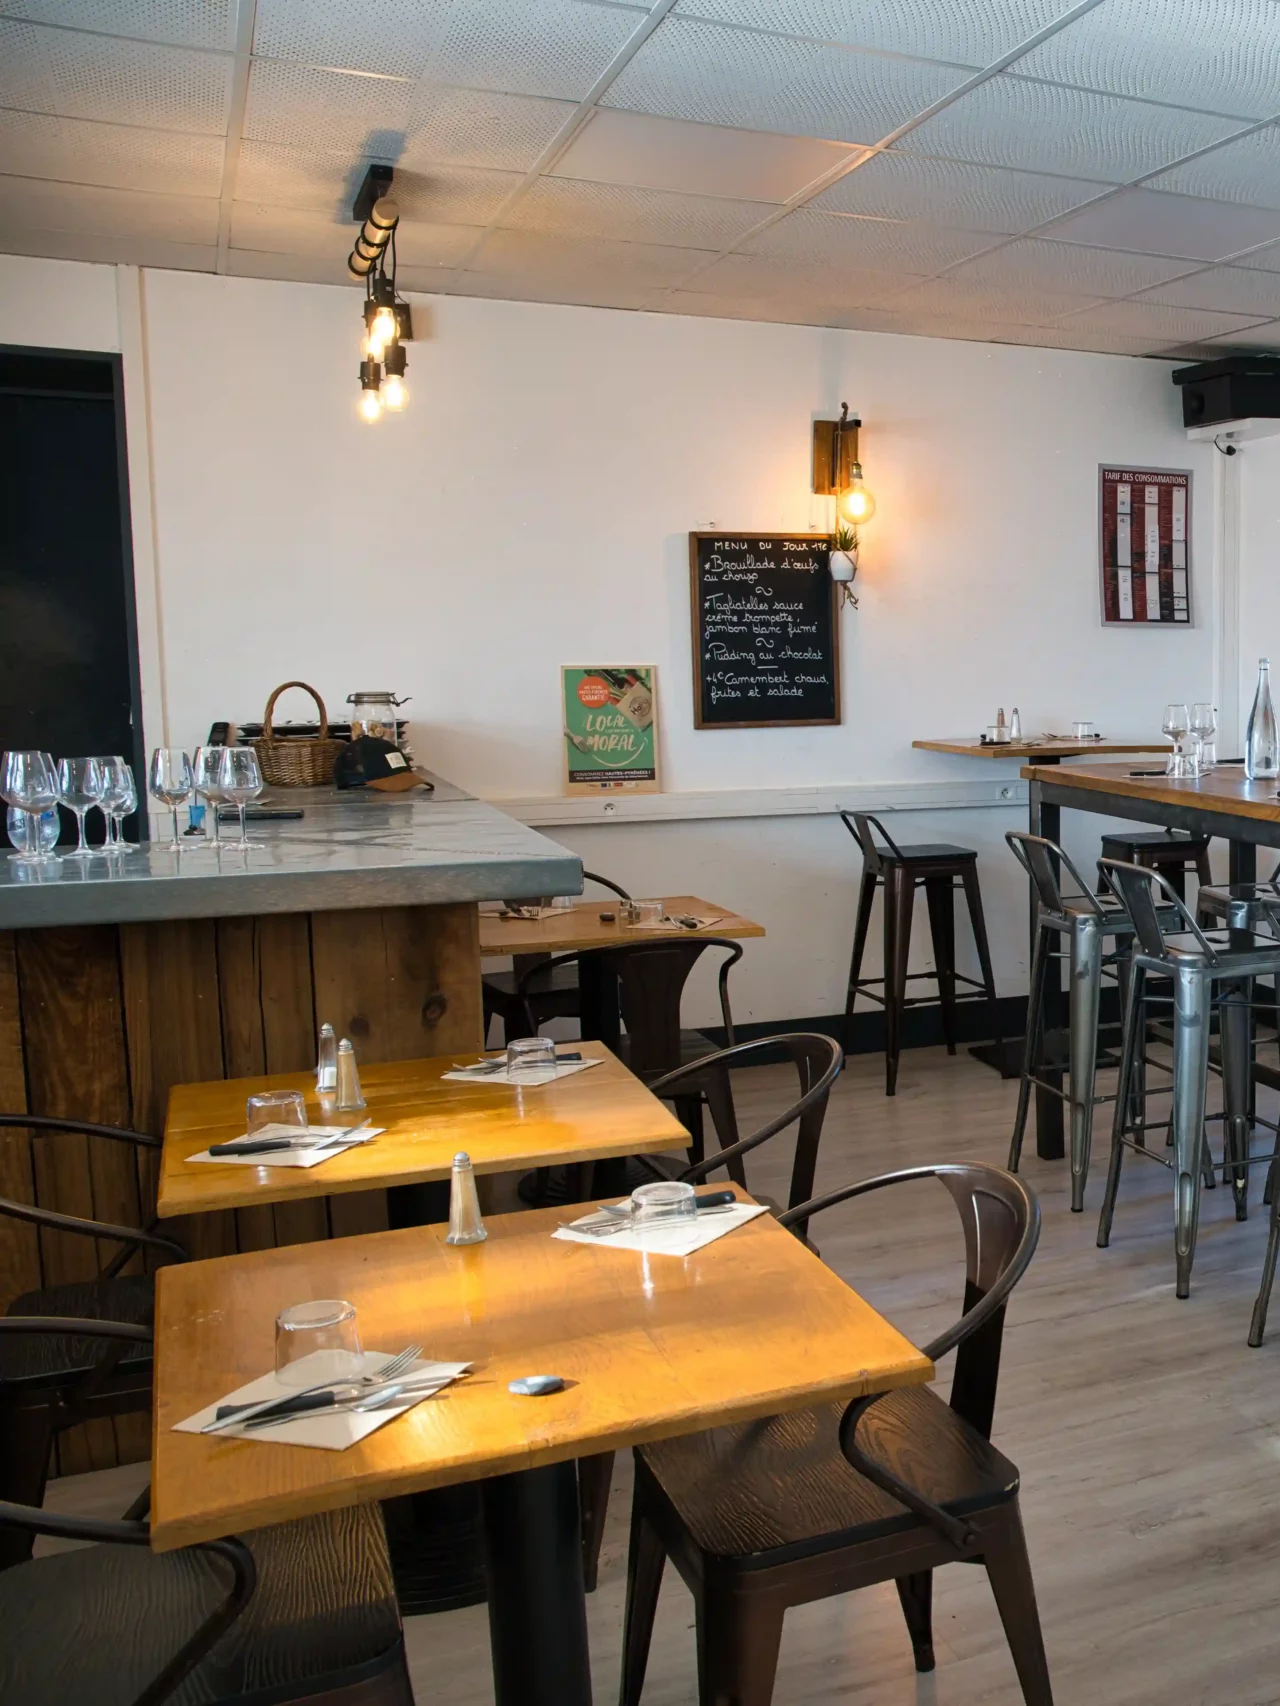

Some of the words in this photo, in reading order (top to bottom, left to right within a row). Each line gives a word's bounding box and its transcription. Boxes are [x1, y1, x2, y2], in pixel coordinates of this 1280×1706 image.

[1104, 471, 1121, 480] TARIF
[1122, 473, 1133, 481] DES
[1134, 474, 1187, 485] CONSOMMATIONS
[714, 541, 748, 550] MENU
[759, 542, 772, 550] DU
[722, 571, 758, 583] chorizo
[773, 602, 803, 610] sauce
[705, 623, 748, 639] jambon
[752, 624, 782, 634] blanc
[787, 621, 818, 638] fumé
[778, 645, 823, 660] chocolat
[711, 686, 741, 704] frites
[747, 688, 761, 697] et
[767, 685, 804, 697] salade
[586, 714, 627, 732] LOCAL
[586, 734, 639, 753] MORAL
